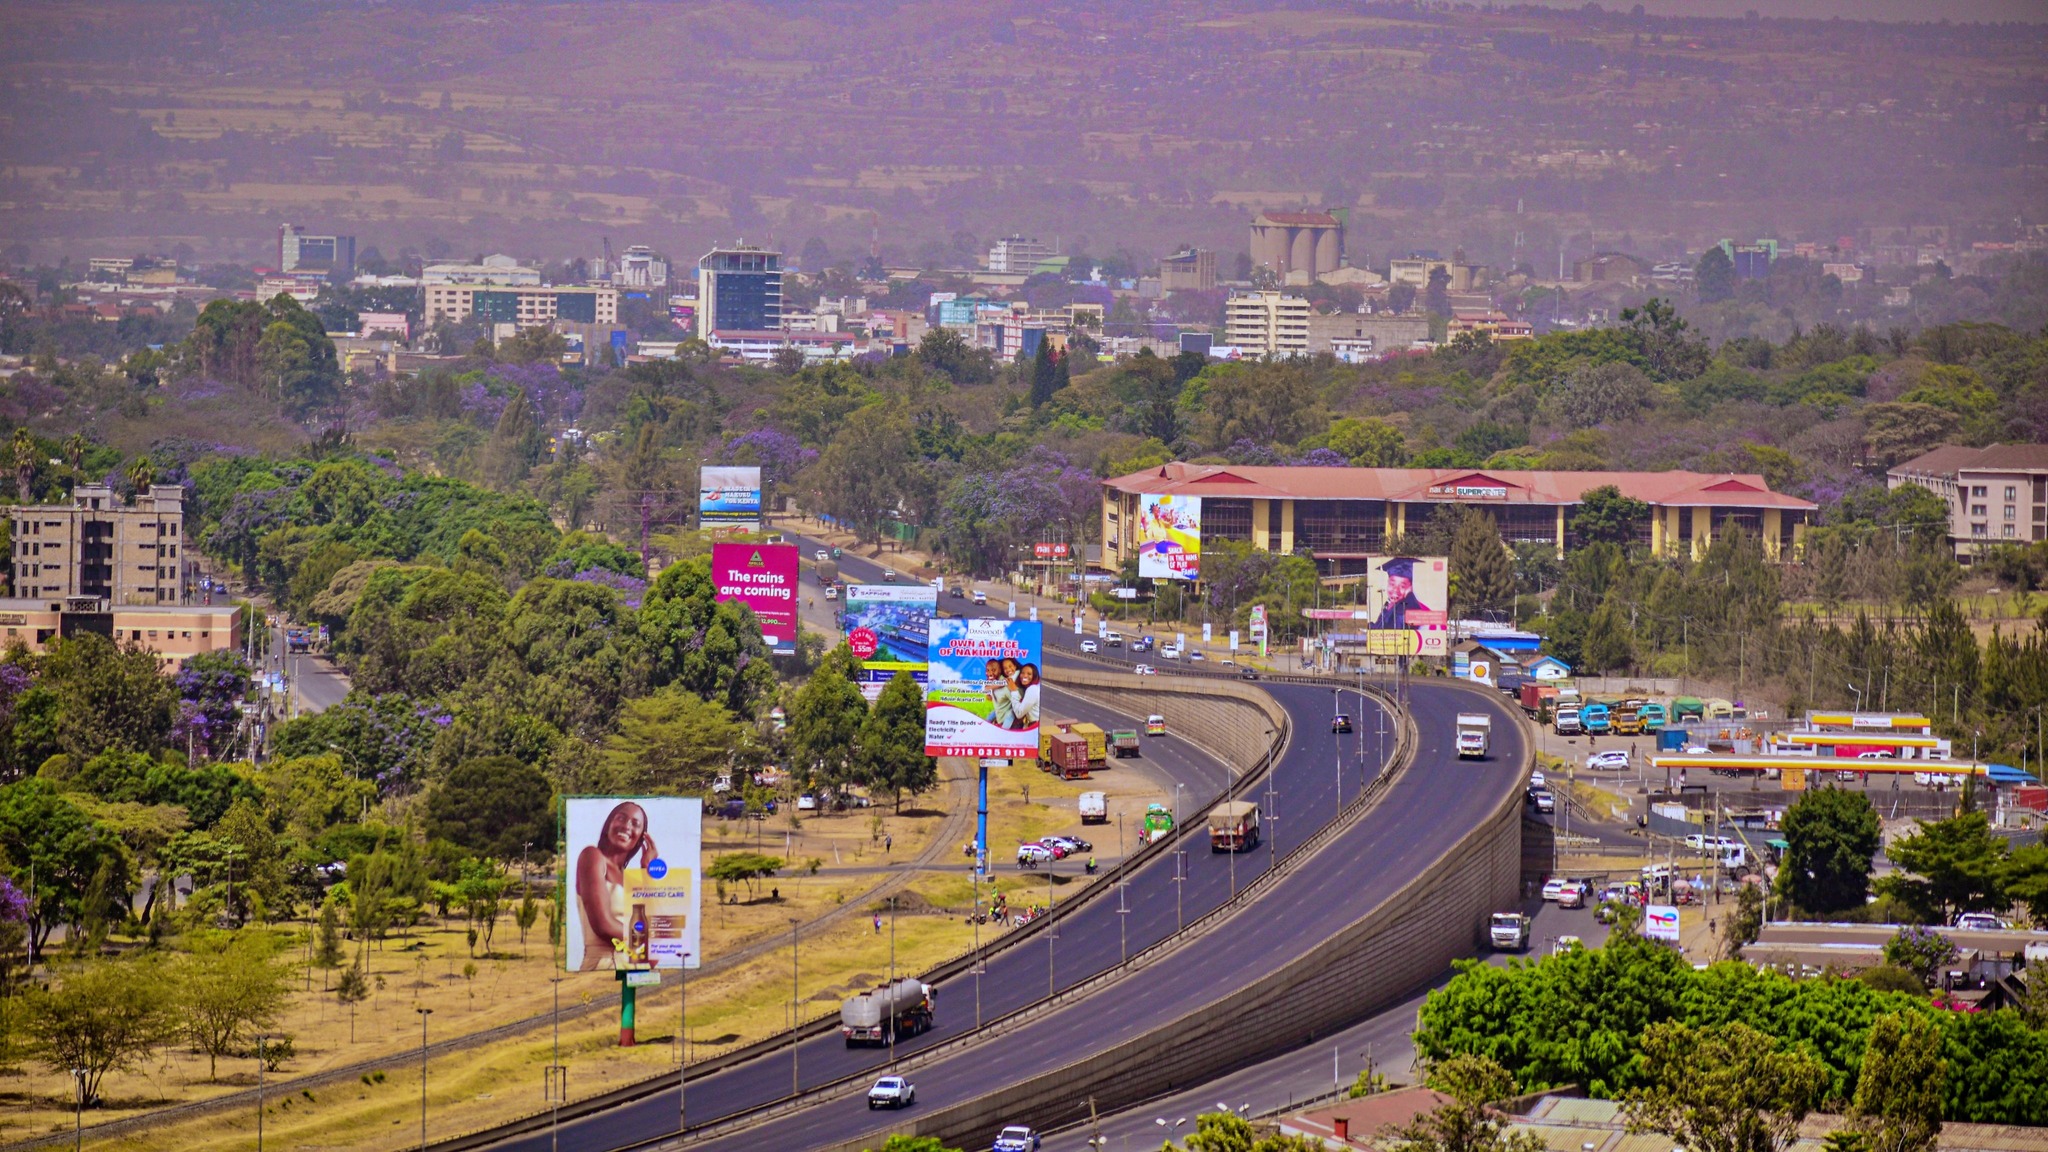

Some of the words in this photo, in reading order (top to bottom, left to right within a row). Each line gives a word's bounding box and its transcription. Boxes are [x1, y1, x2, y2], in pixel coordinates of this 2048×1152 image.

[728, 570, 750, 582] The
[753, 571, 784, 584] rains
[720, 586, 742, 595] are
[744, 584, 791, 600] coming
[950, 640, 975, 648] OWN
[989, 641, 1018, 649] PIECE
[939, 648, 953, 656] OF
[956, 649, 1000, 657] NAKURU
